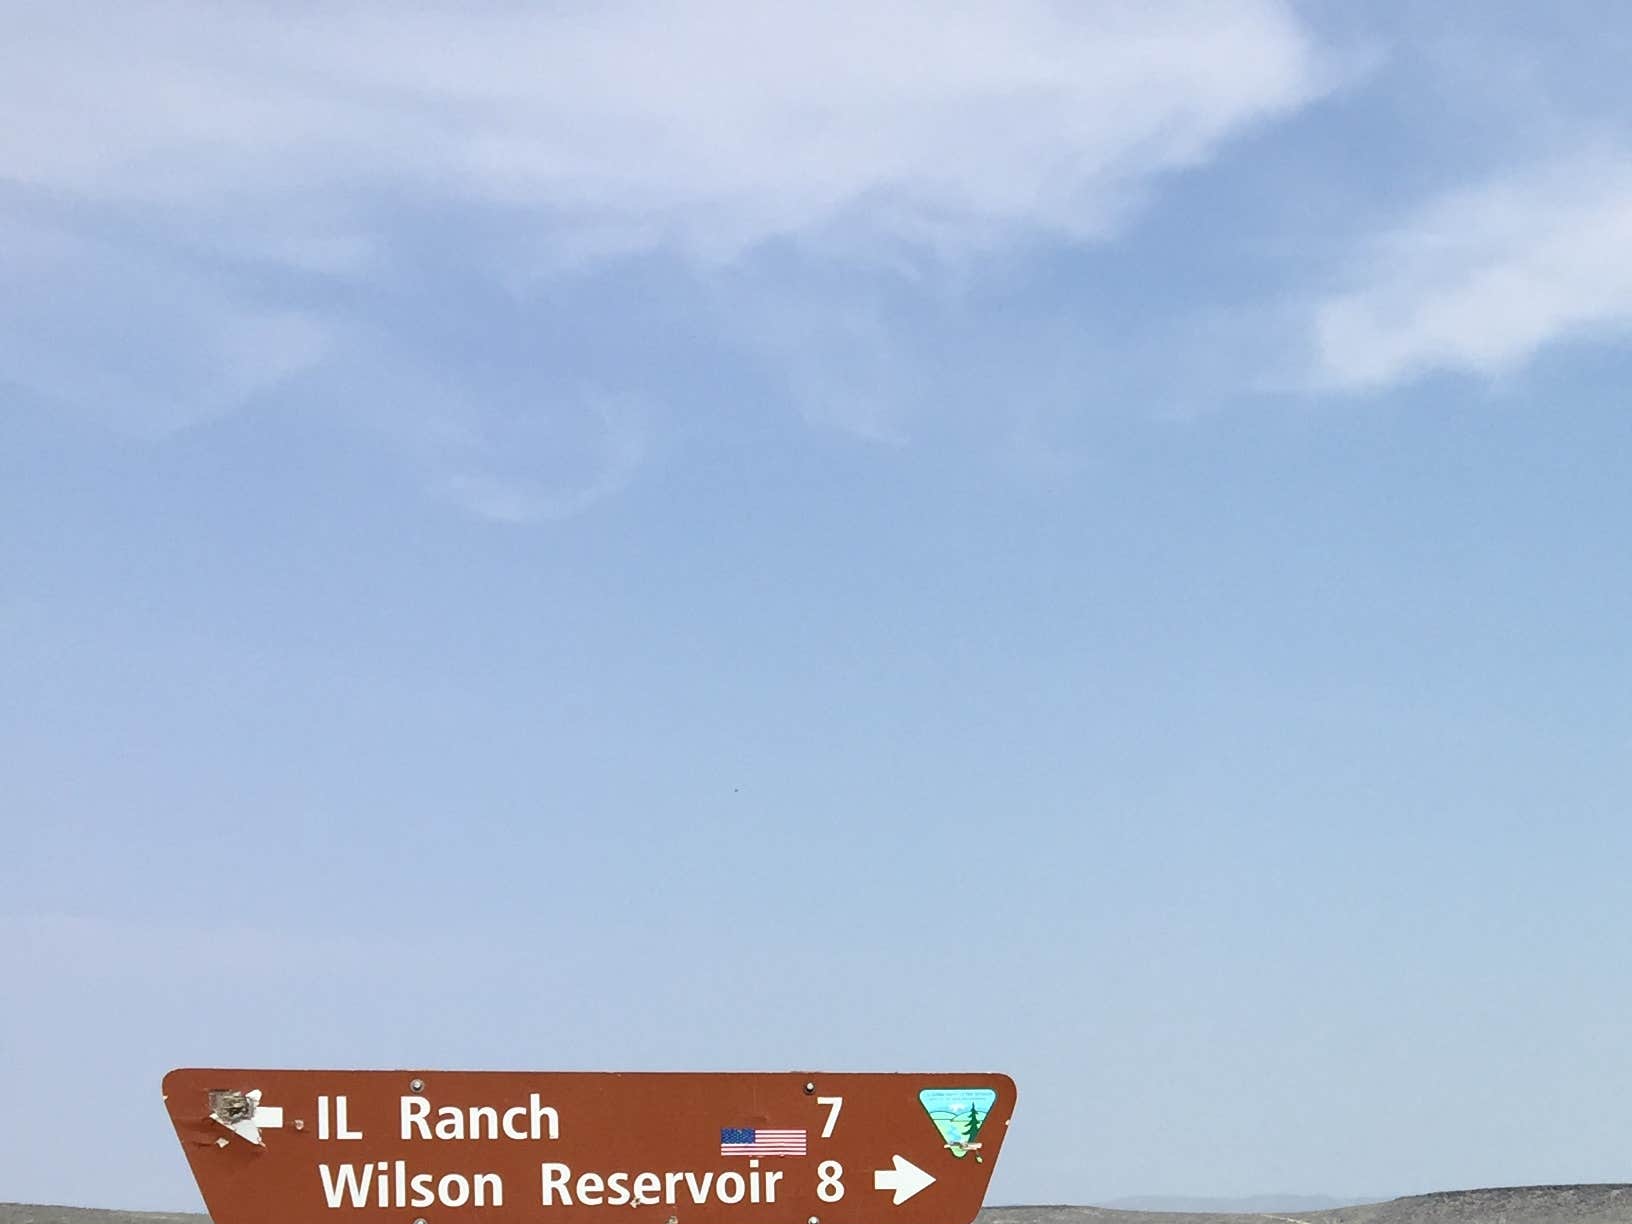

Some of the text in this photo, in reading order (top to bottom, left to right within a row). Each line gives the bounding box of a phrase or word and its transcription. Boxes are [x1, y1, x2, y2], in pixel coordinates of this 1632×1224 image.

[318, 1094, 843, 1139] IL Ranch 7
[319, 1160, 844, 1207] Wilson Reservoir 8
